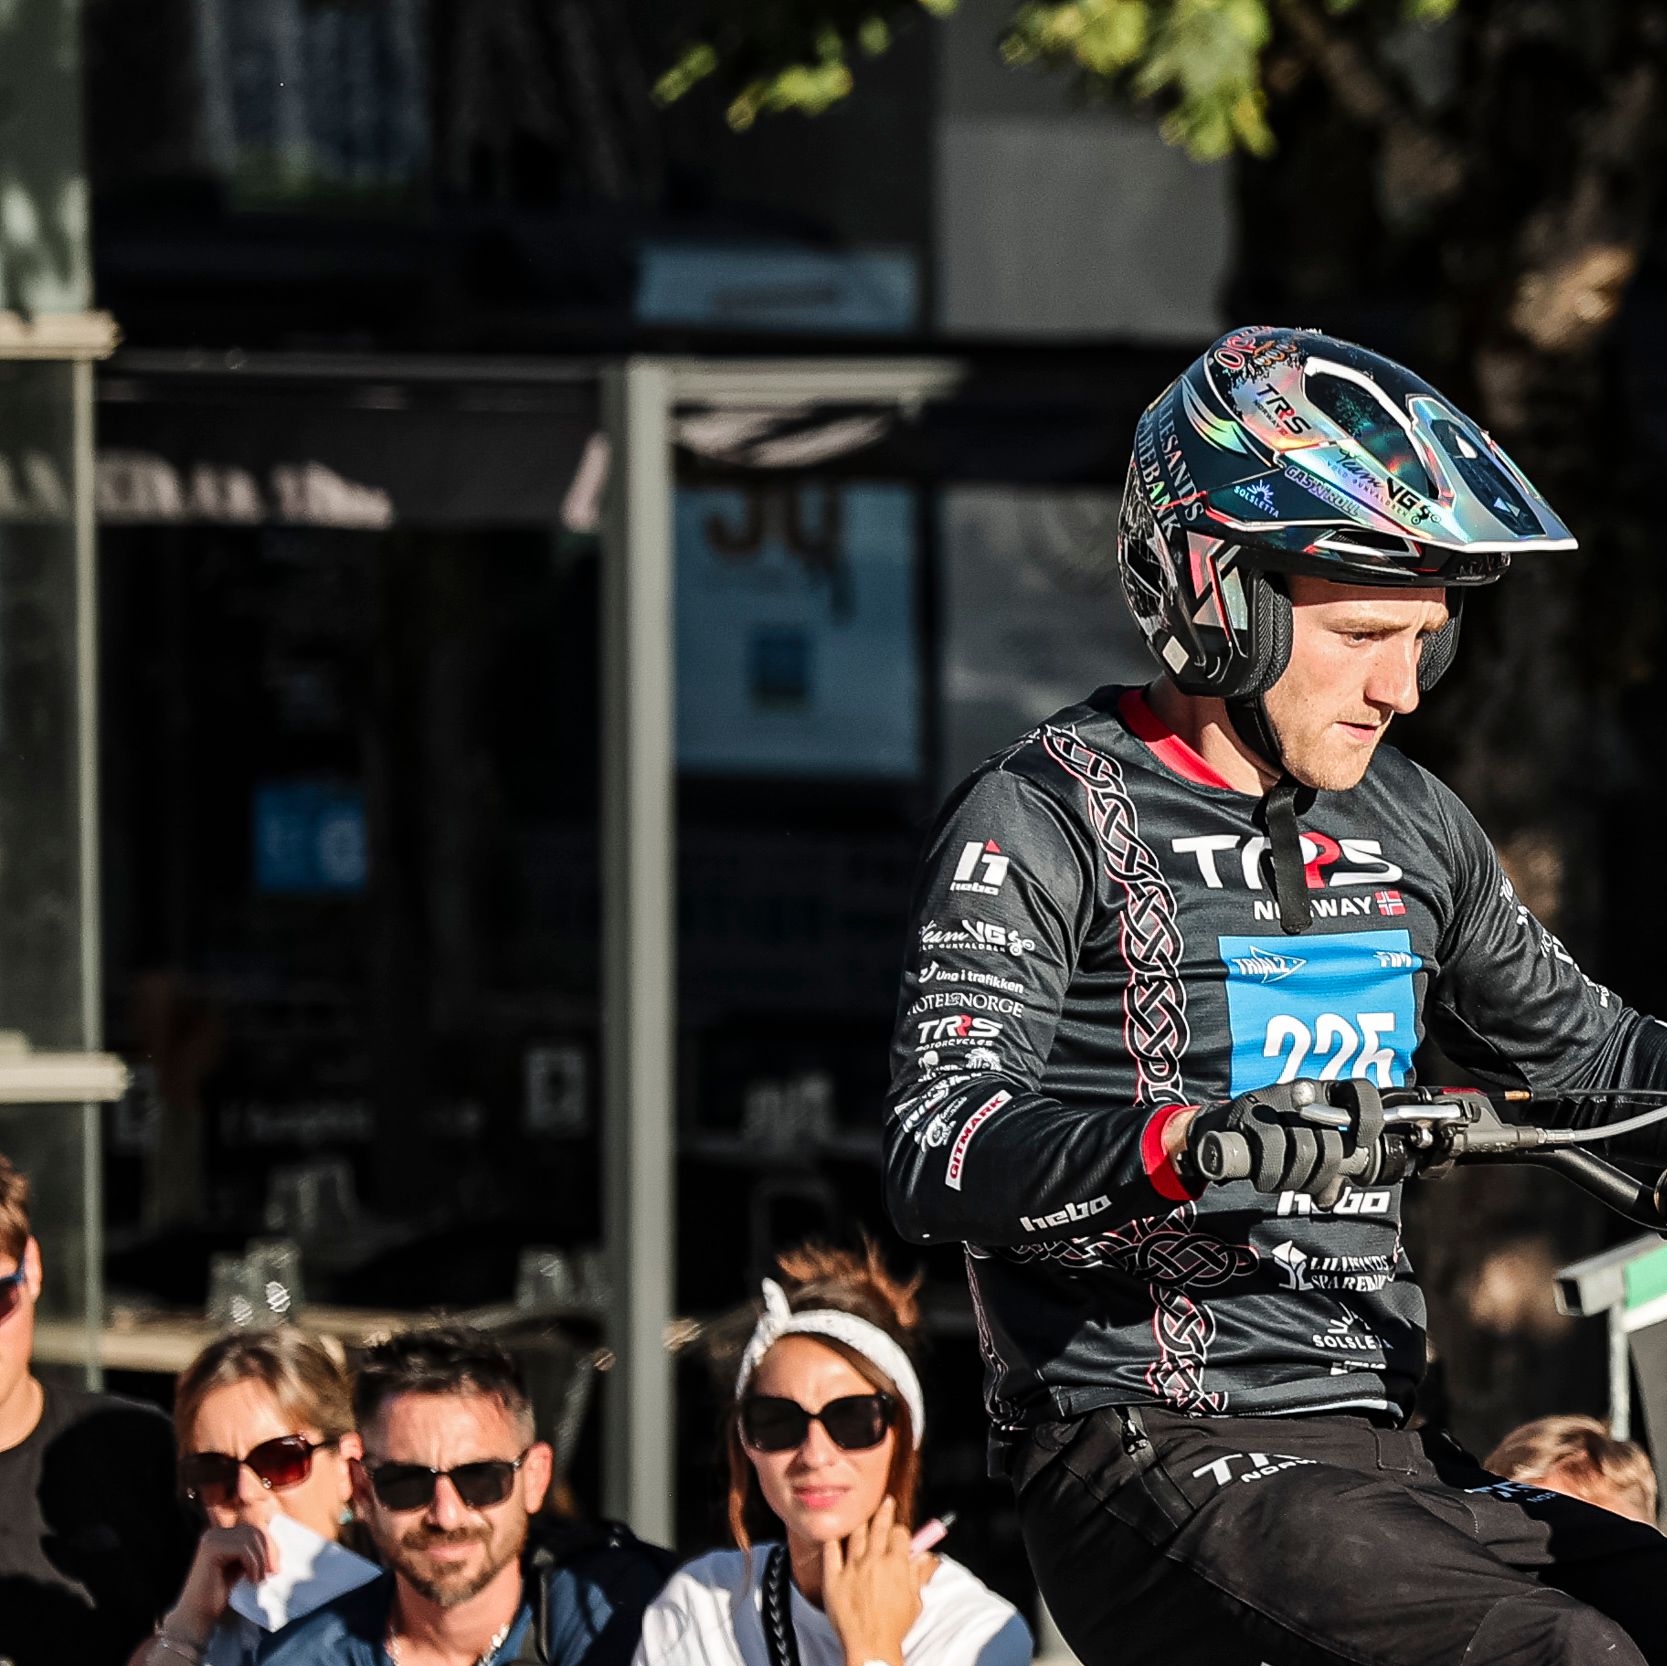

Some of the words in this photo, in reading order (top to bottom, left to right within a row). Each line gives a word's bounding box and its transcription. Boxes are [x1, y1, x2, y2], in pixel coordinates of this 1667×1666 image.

[1233, 486, 1280, 518] SOLSLETTA
[1387, 477, 1421, 511] VG
[961, 920, 1006, 945] VG
[968, 971, 1024, 993] trafikken
[959, 993, 1024, 1018] NORGE
[1263, 1012, 1396, 1088] 225
[949, 1096, 1004, 1180] GITMARK
[1020, 1195, 1112, 1232] hebo
